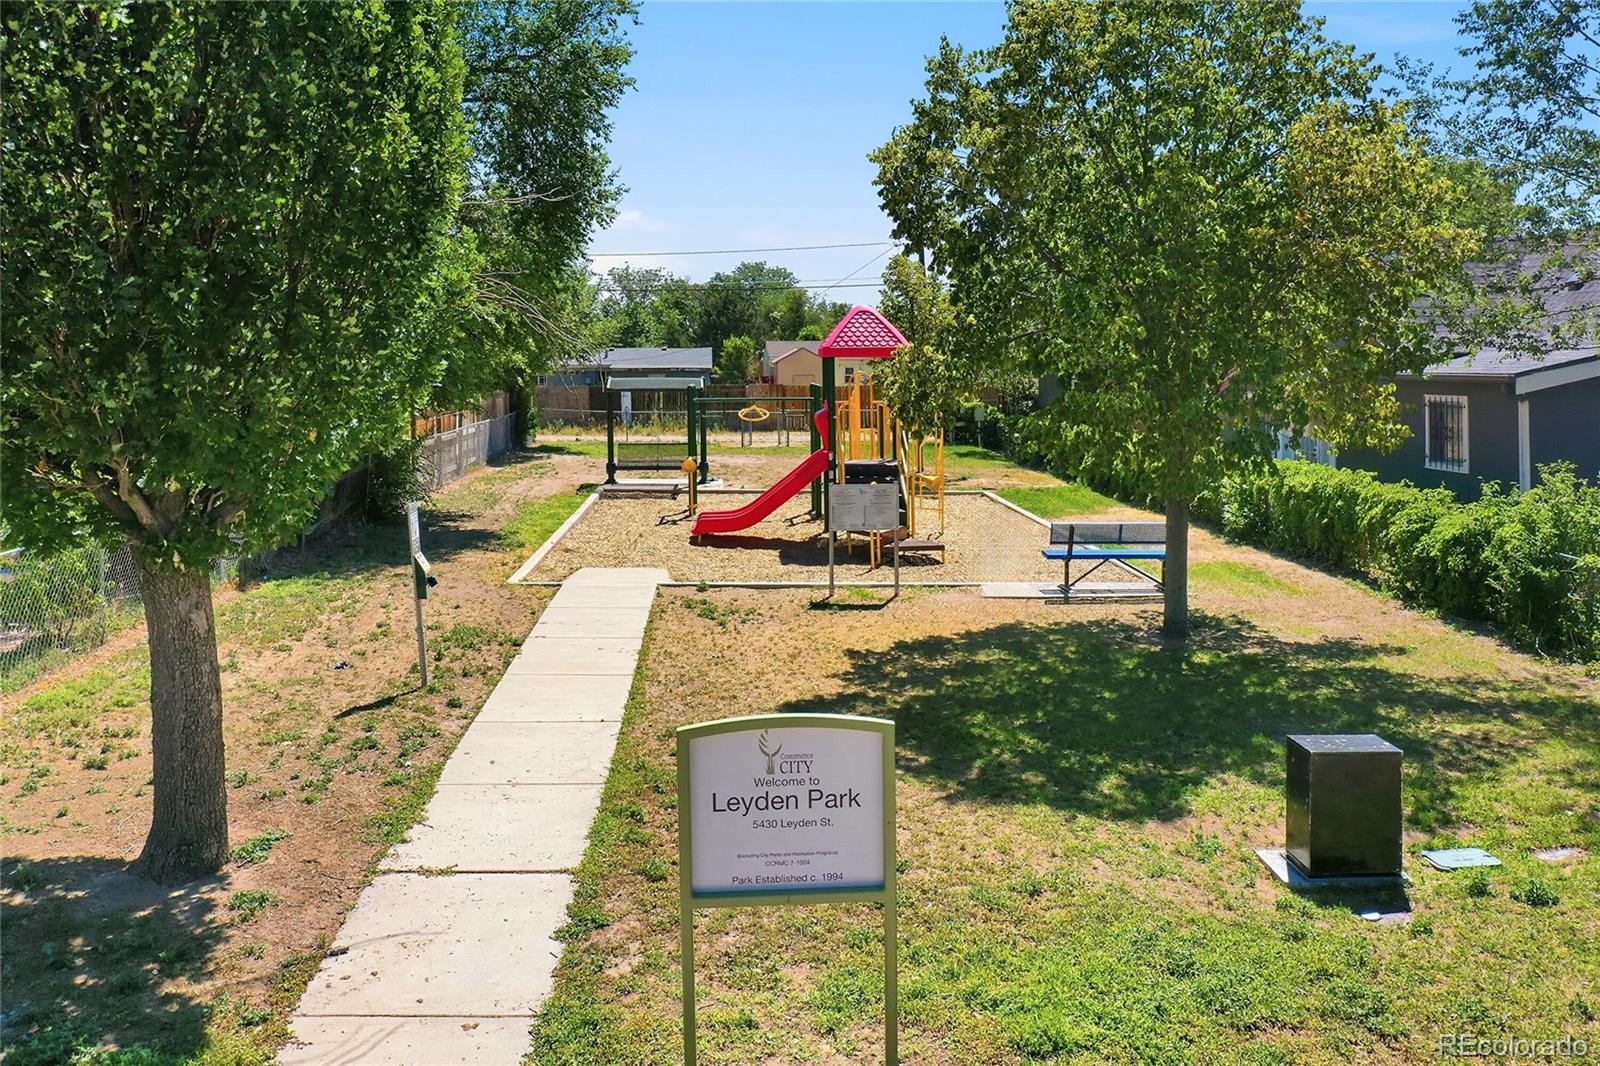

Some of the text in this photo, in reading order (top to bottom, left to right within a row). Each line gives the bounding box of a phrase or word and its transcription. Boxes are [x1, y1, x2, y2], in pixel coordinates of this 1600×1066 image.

[780, 760, 813, 774] CITY
[754, 777, 820, 787] Welcome to
[712, 788, 862, 817] Leyden Park
[752, 817, 834, 830] 5430 Leyden St.
[732, 872, 844, 885] Park Established c. 1994
